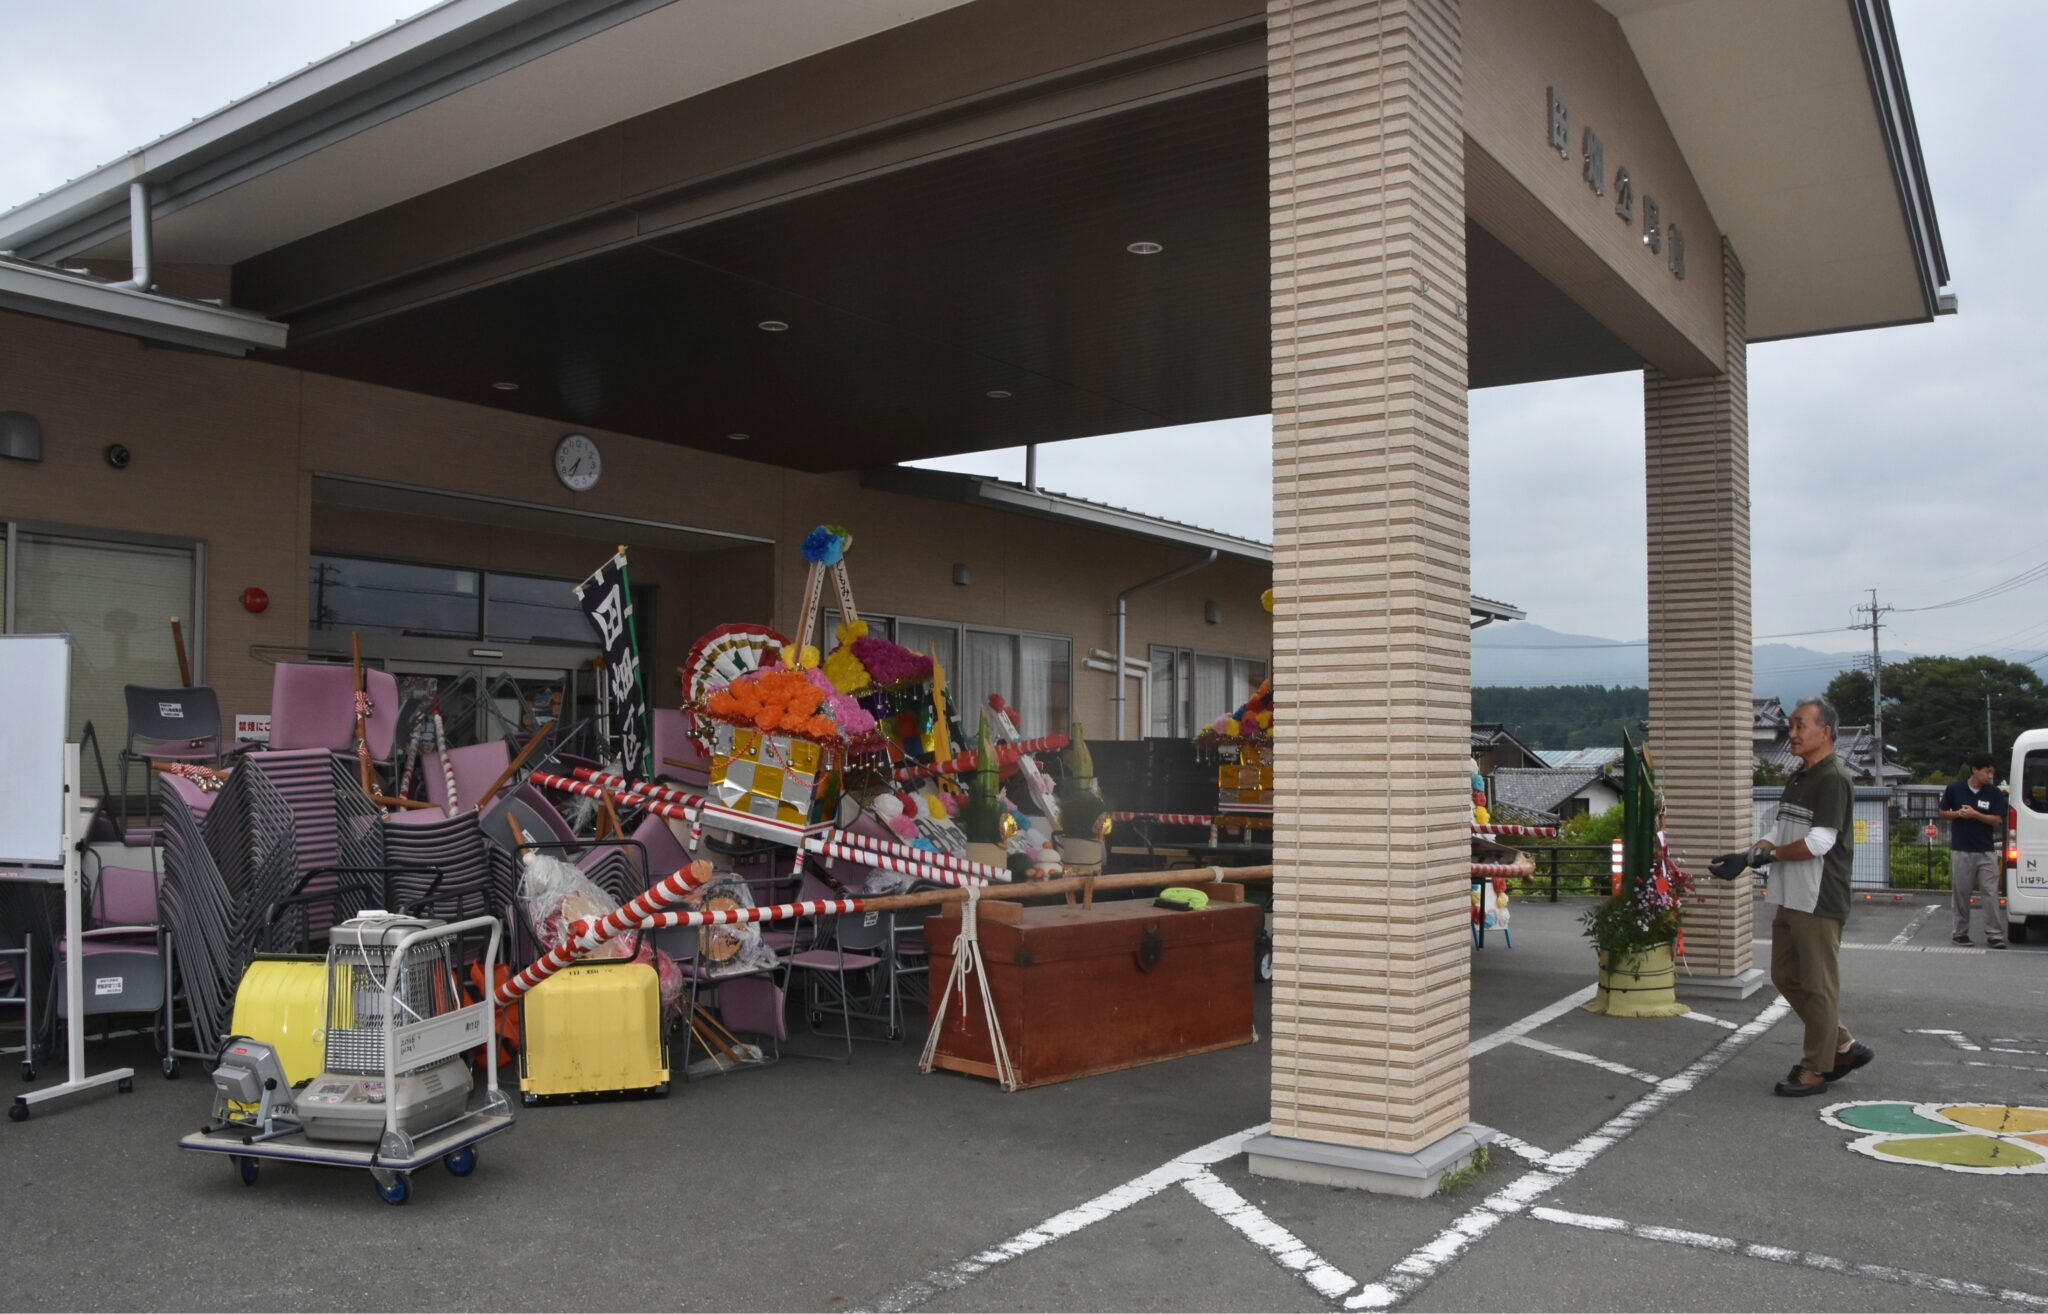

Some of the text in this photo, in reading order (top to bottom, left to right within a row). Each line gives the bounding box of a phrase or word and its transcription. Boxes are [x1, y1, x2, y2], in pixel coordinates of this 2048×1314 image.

[591, 583, 642, 772] 田畑区
[2027, 860, 2036, 868] N
